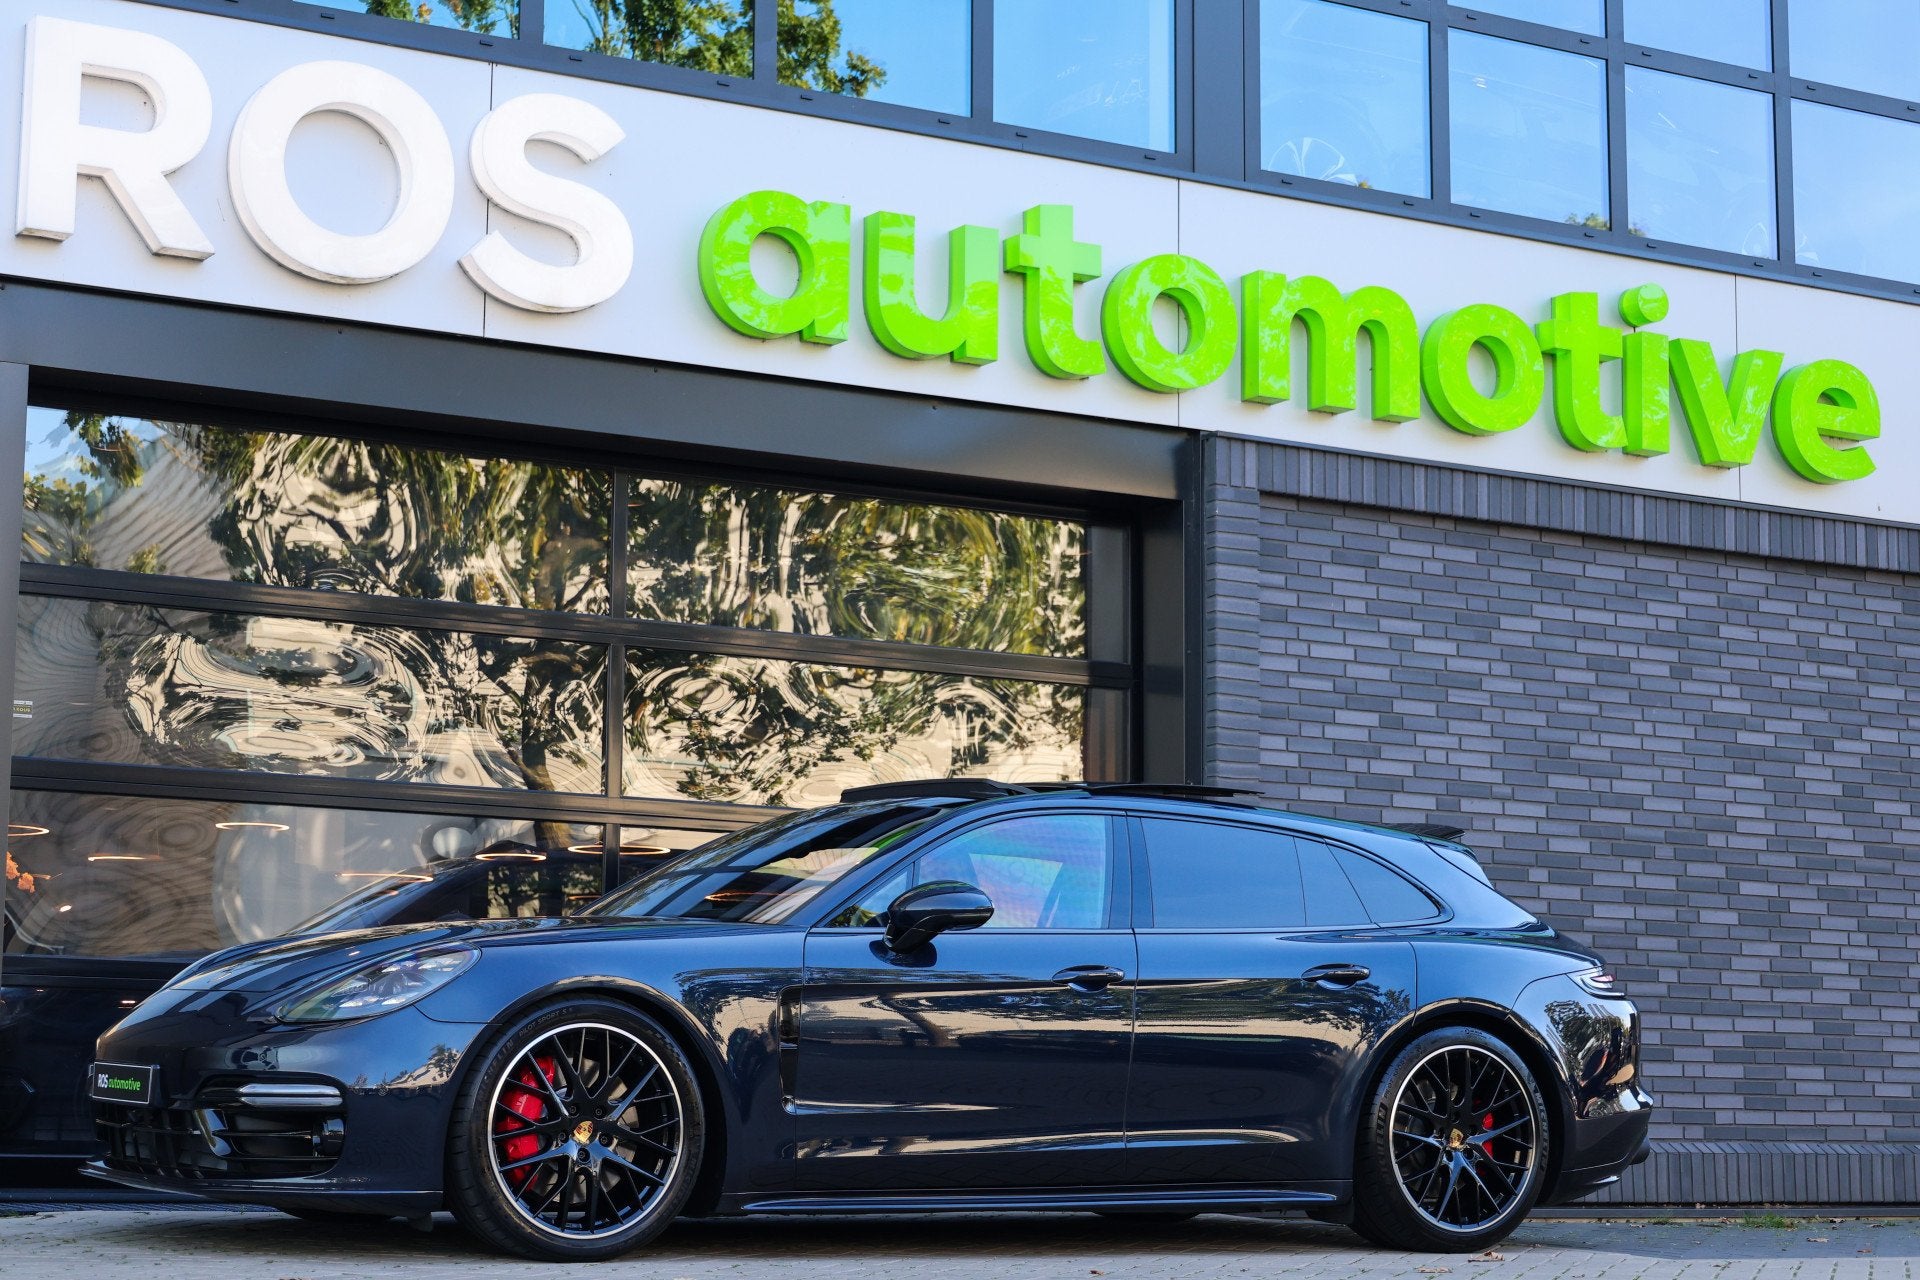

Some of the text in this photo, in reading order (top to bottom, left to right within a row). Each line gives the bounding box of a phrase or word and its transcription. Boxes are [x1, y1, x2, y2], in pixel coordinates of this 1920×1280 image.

[14, 14, 1881, 485] ROS automotive
[519, 1022, 539, 1037] PILOT
[537, 1010, 560, 1024] SPORT
[98, 1073, 141, 1090] ROS automotive
